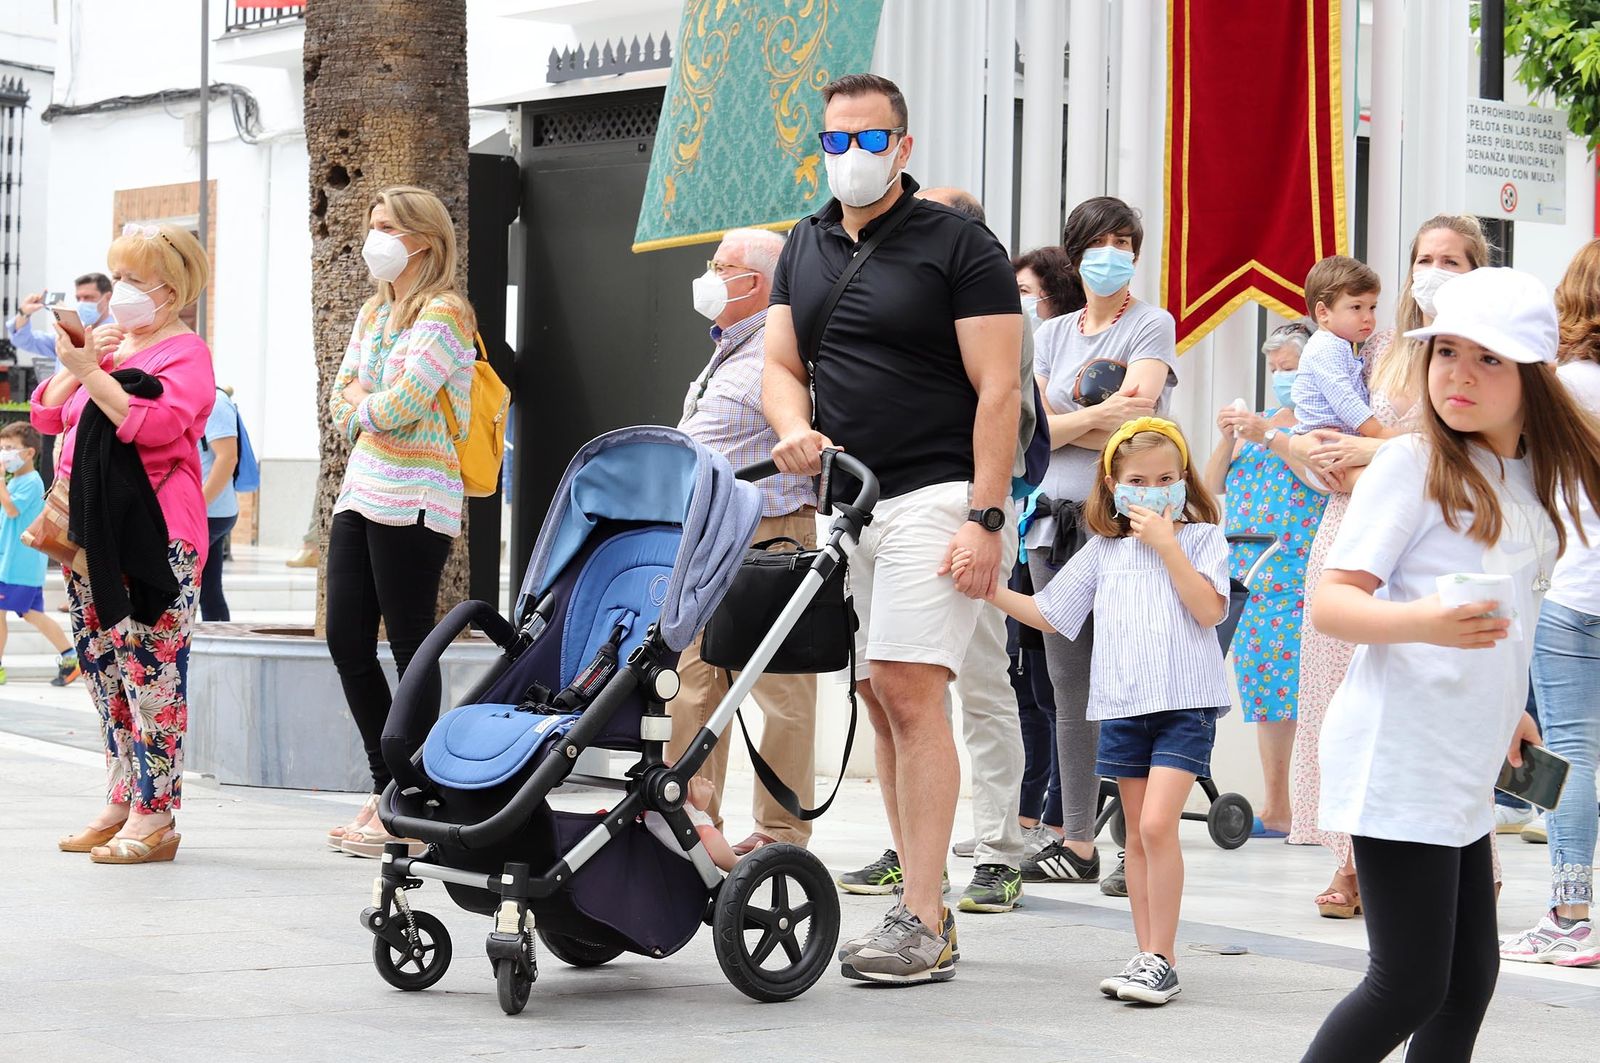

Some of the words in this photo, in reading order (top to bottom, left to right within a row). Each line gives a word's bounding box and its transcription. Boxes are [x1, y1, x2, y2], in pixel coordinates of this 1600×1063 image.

[1481, 106, 1525, 121] PROHIBIDO
[1527, 112, 1553, 125] JUGAR
[1470, 119, 1500, 131] PELOTA
[1503, 123, 1513, 134] EN
[1515, 126, 1531, 136] LAS
[1533, 128, 1562, 141] PLAZAS
[1467, 149, 1506, 162] DENANZA
[1508, 154, 1549, 168] MUNICIPAL
[1551, 159, 1556, 169] Y
[1467, 164, 1510, 178] NCIONADO
[1512, 169, 1528, 180] CON
[1531, 171, 1556, 183] MULTA
